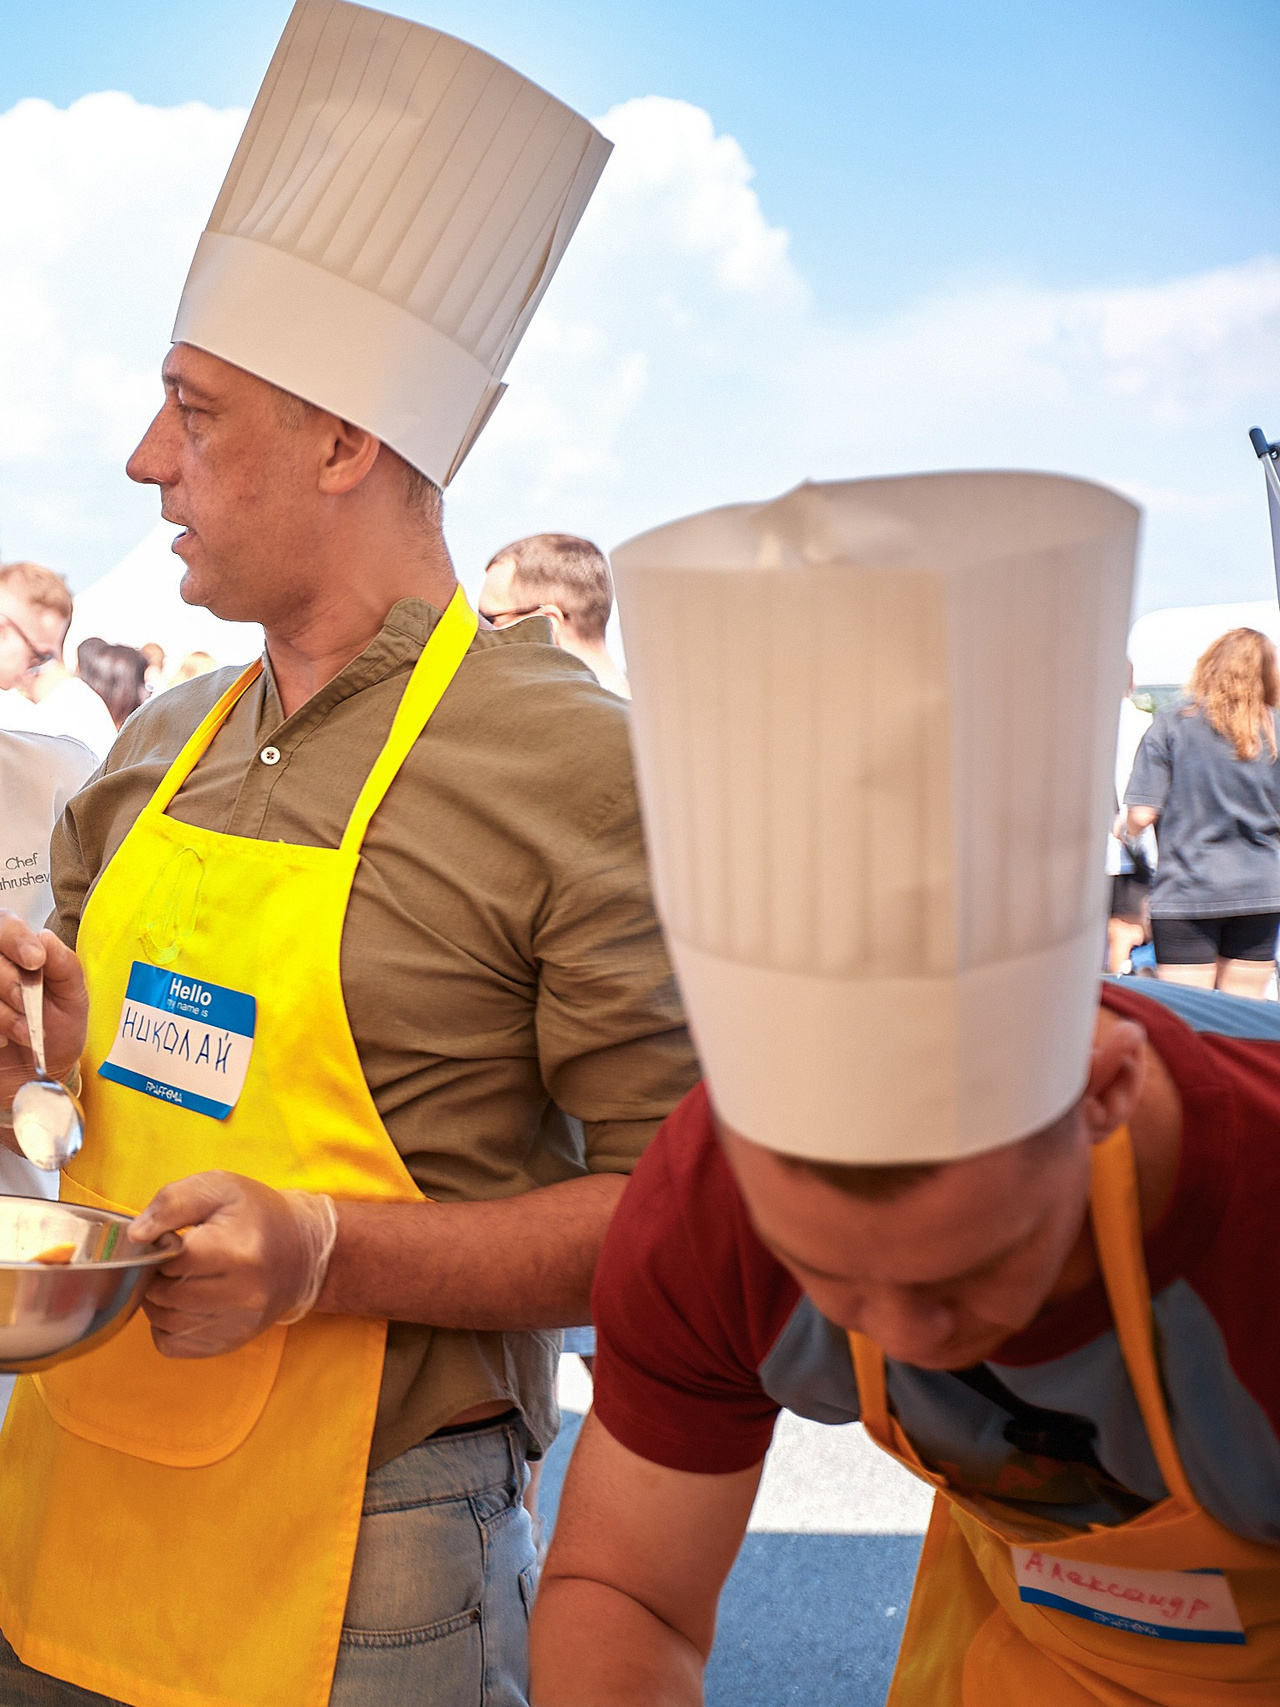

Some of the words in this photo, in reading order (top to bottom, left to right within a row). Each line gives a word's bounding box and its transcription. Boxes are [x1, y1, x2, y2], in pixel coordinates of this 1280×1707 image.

[5, 852, 38, 870] Chef
[169, 977, 213, 1007] Hello
[176, 1001, 201, 1015] name
[201, 1006, 209, 1018] is
[121, 1006, 233, 1074] НИКОЛАЙ
[1024, 1551, 1211, 1620] Александр
